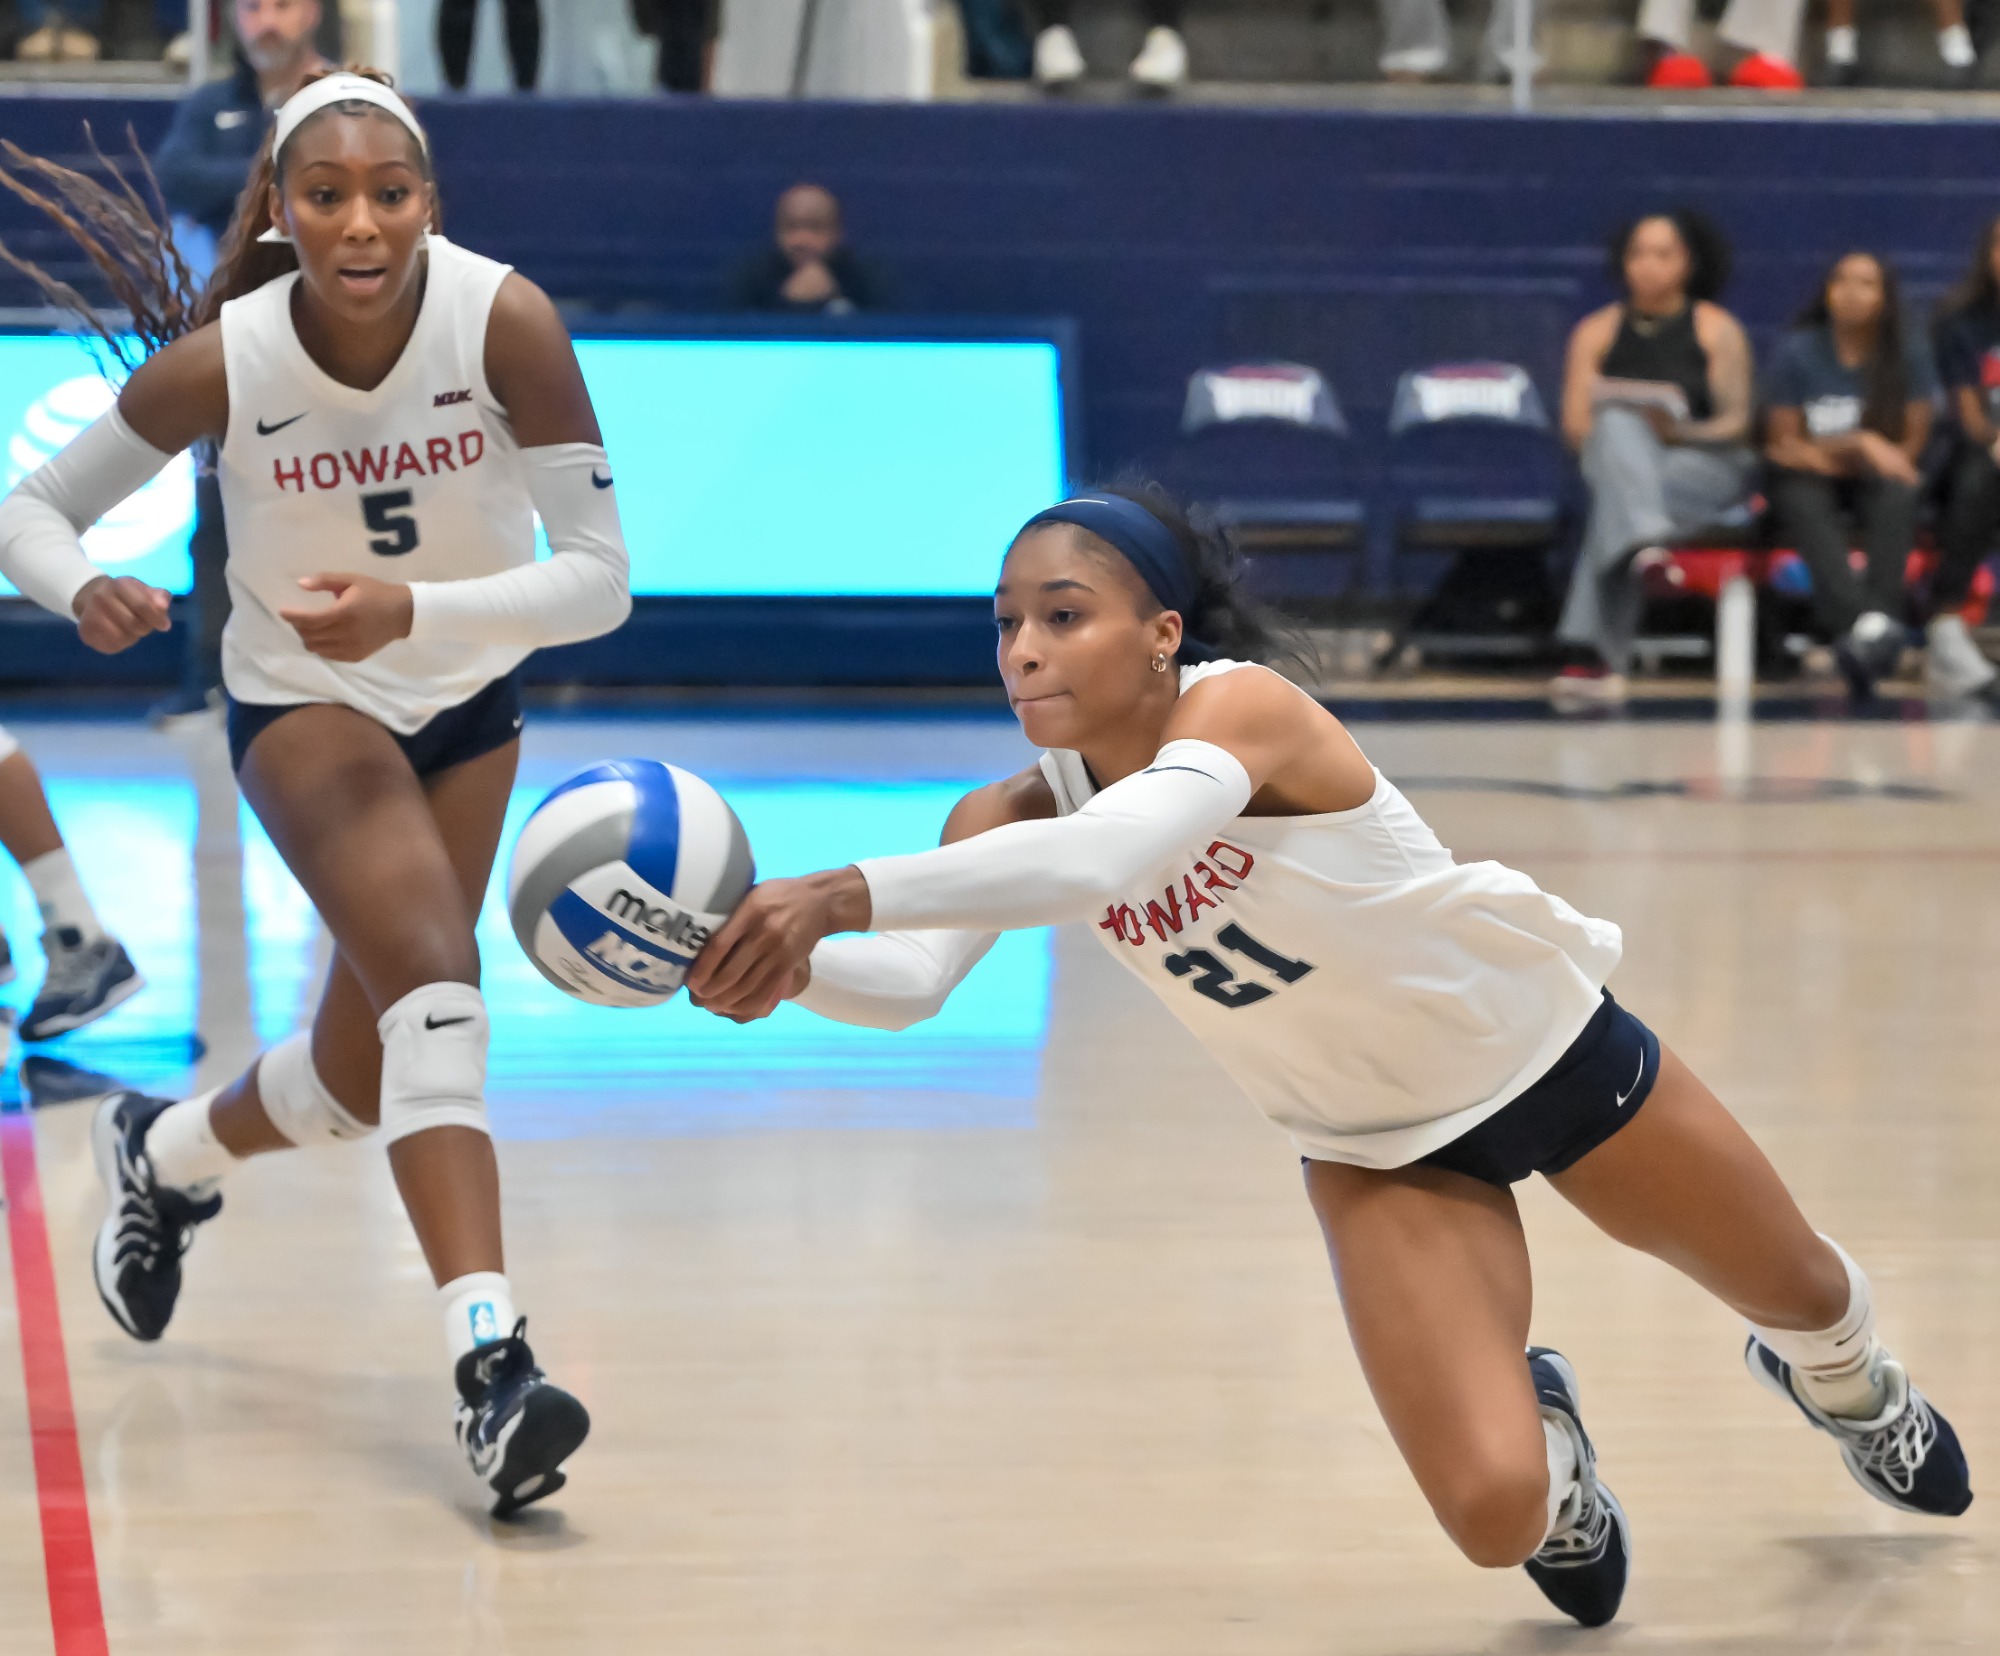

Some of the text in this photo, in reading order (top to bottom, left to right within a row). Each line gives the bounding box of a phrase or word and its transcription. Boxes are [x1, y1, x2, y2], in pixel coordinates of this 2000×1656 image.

[273, 429, 484, 493] HOWARD
[359, 487, 420, 557] 5
[604, 888, 711, 951] molte
[1098, 840, 1255, 947] HOWARD
[1162, 918, 1319, 1010] 21
